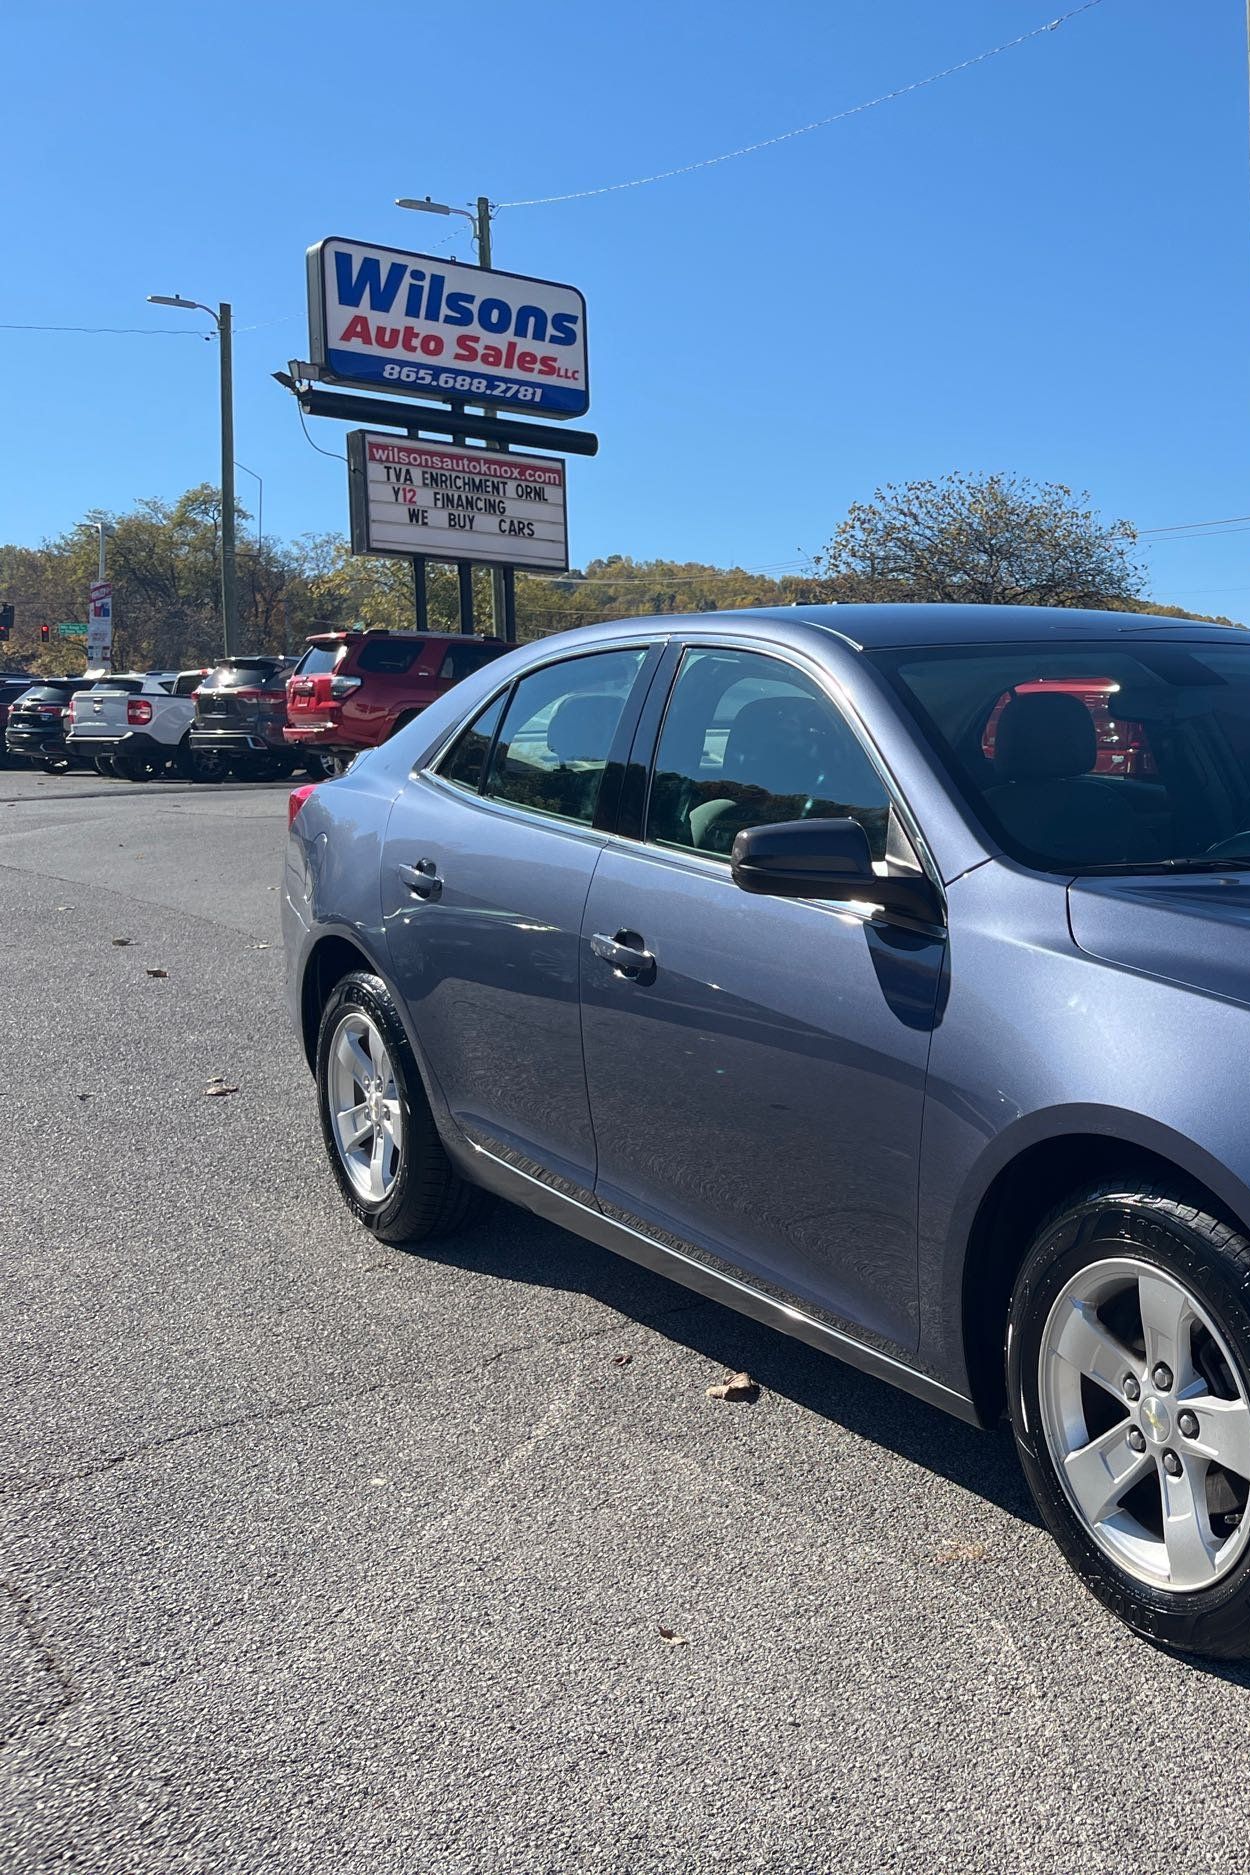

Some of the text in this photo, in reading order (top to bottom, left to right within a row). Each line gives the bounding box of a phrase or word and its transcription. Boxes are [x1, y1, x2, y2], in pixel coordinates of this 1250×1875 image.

[334, 250, 579, 346] Wilsons
[339, 314, 579, 381] Auto Sales LLC
[382, 363, 543, 402] 865.688.2781
[372, 446, 560, 485] wilsonsautoknox.com
[384, 465, 549, 502] TVA ENRICHMENT ORNL
[392, 486, 506, 515] Y12 FINANCING
[407, 507, 535, 537] WE BUY CARS
